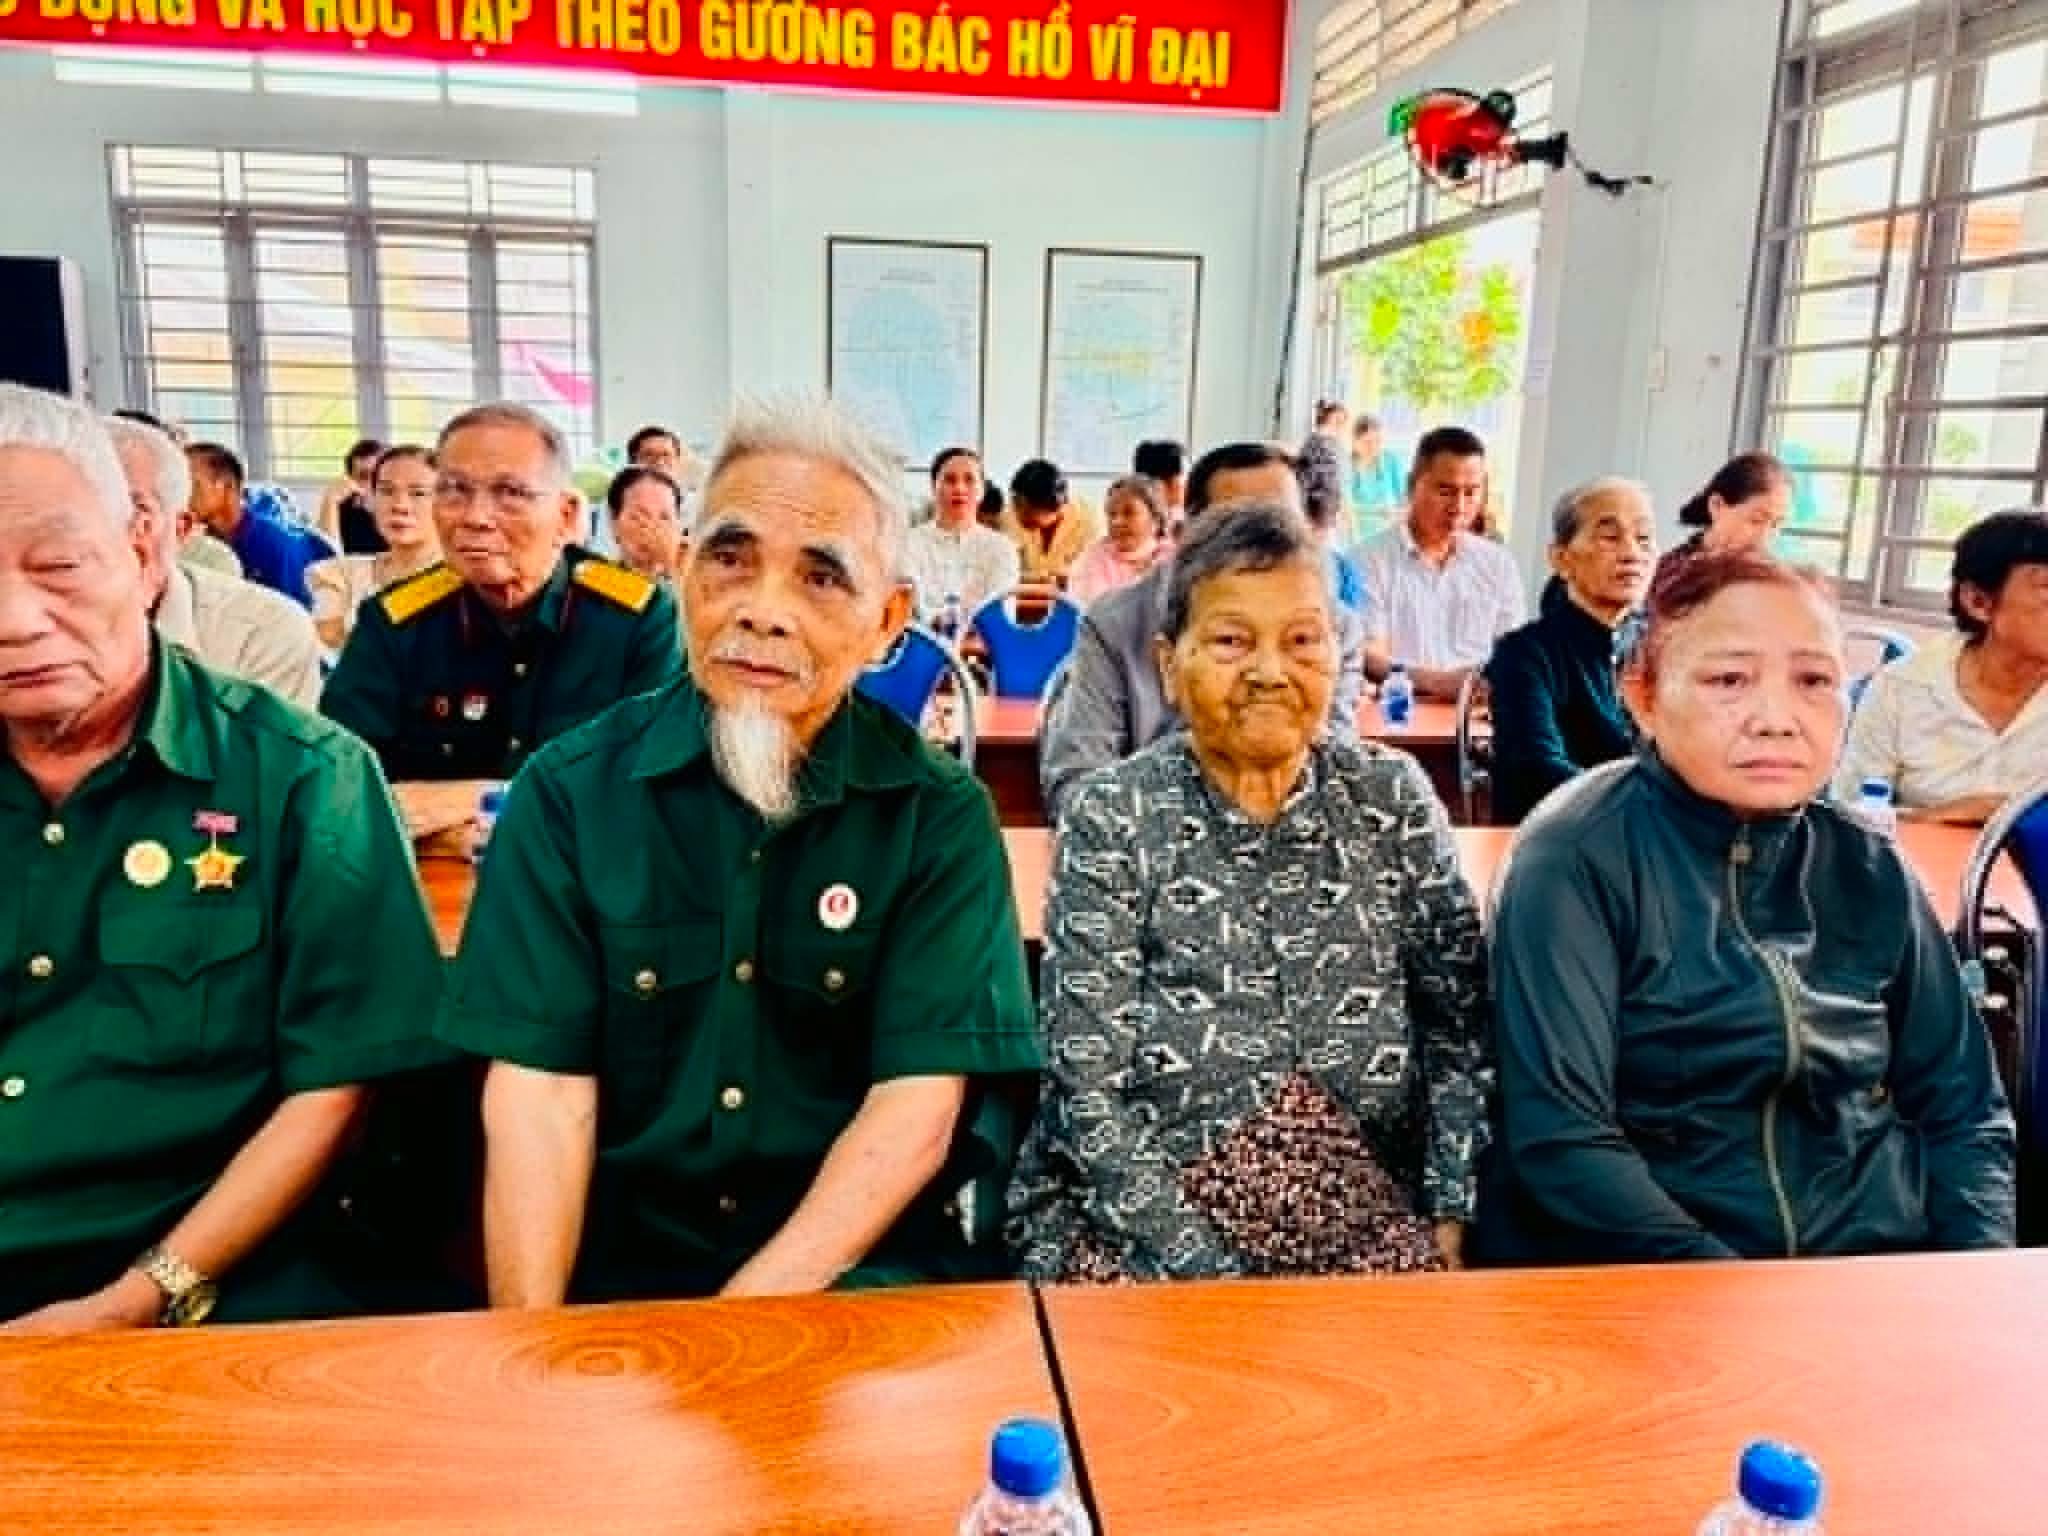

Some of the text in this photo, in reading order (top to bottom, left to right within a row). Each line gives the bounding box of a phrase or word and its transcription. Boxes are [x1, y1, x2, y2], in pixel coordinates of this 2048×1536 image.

[556, 0, 681, 55] THEO
[891, 2, 991, 75] BÁC
[1007, 0, 1073, 80] HỒ
[1088, 14, 1136, 84] VĨ
[1148, 27, 1231, 100] ĐẠI
